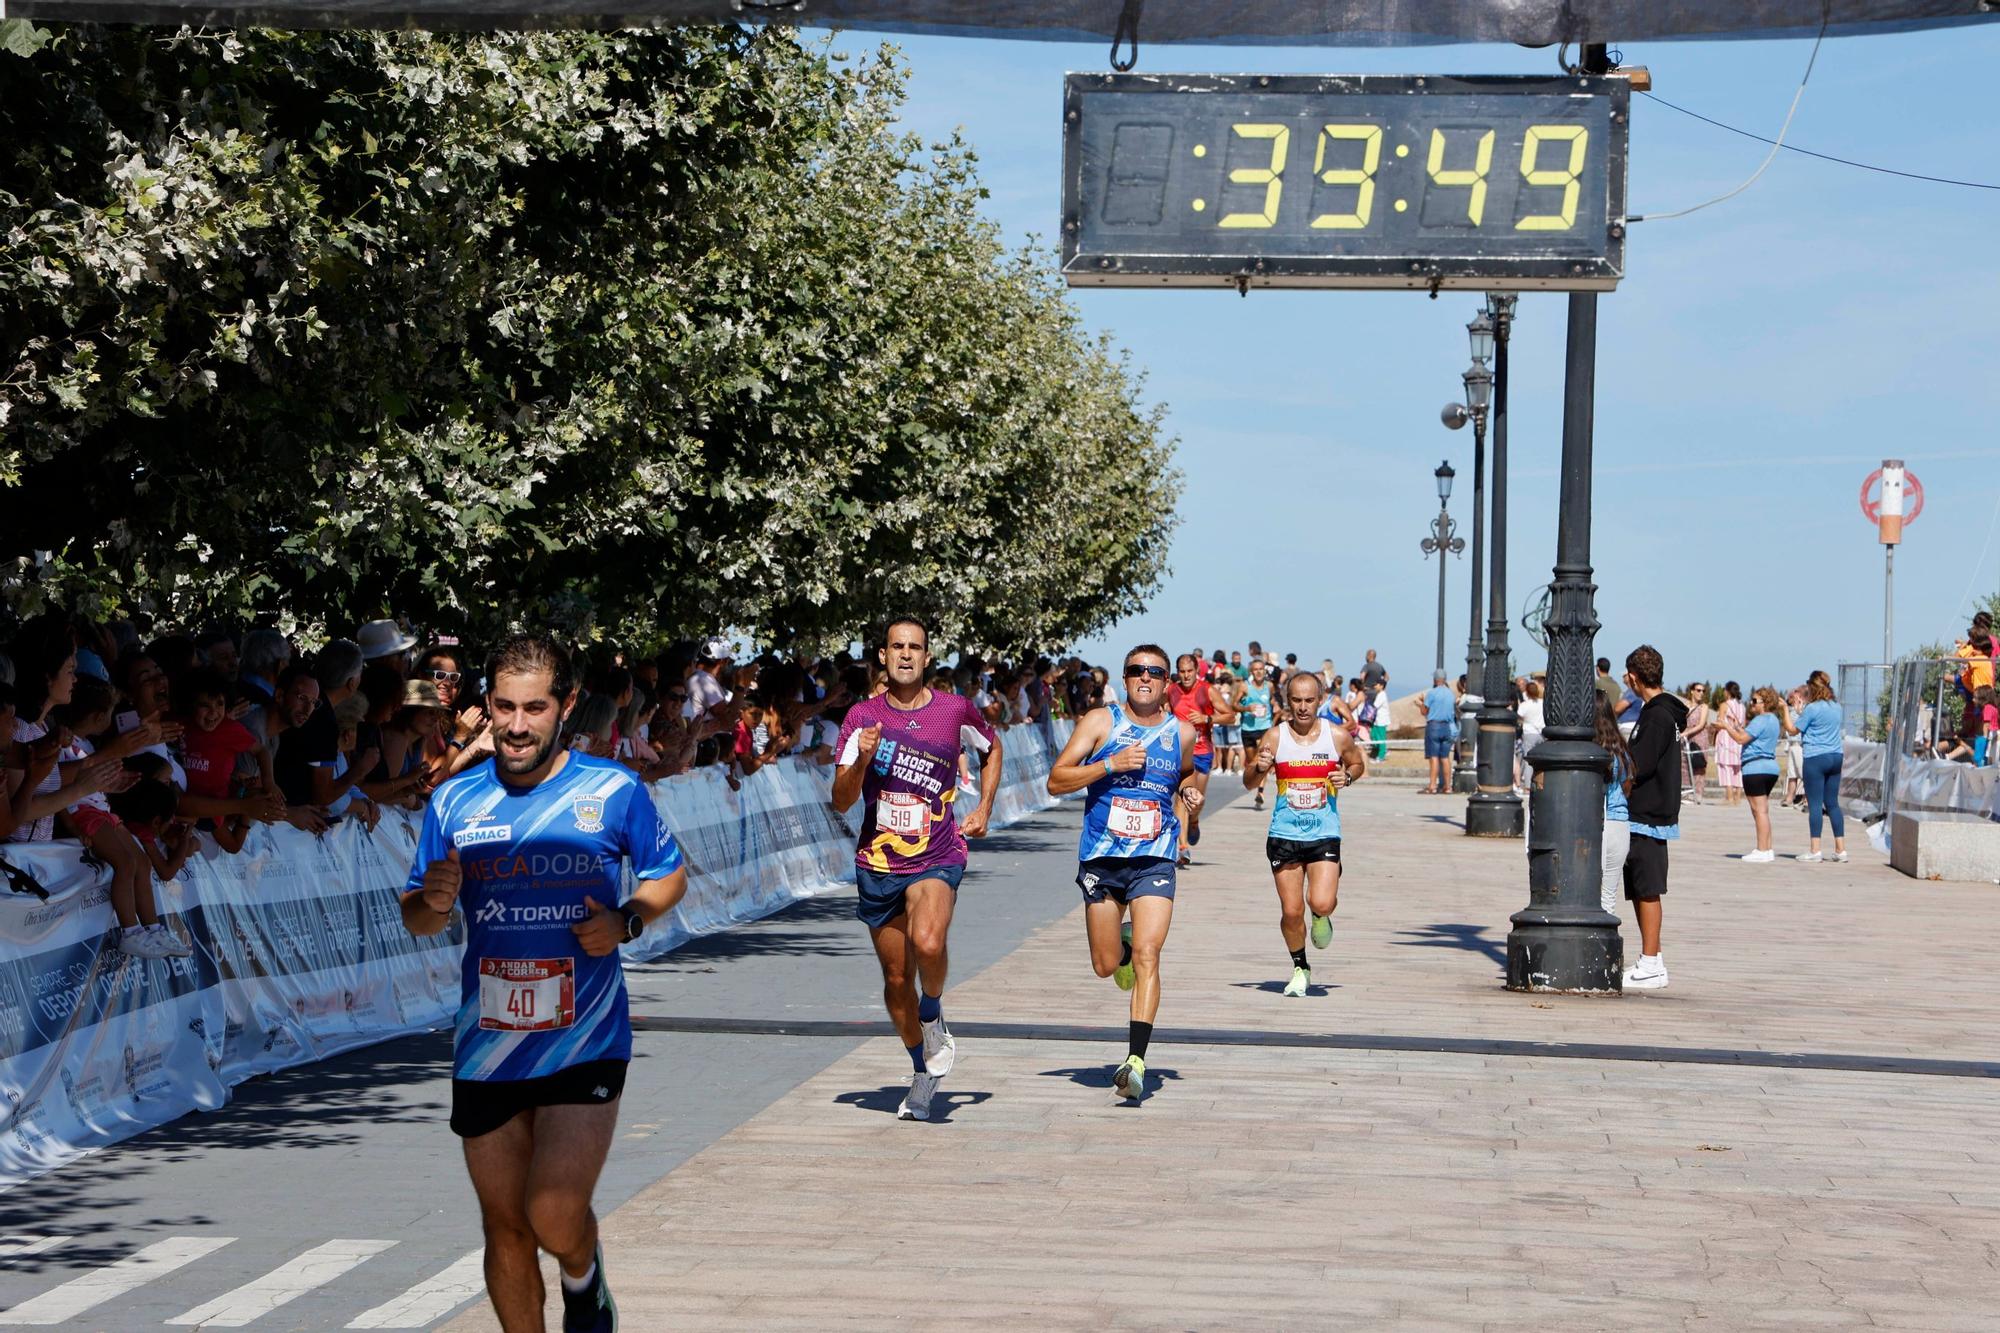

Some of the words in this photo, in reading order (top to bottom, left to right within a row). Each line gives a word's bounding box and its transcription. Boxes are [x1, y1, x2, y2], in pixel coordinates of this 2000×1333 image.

[895, 752, 935, 774] MOST
[1288, 760, 1328, 768] RIBADAVIA
[891, 765, 943, 795] WANTED
[1299, 793, 1312, 805] 68
[890, 809, 911, 828] 519
[1125, 814, 1142, 832] 33
[455, 828, 507, 846] DISMAC
[501, 961, 536, 969] ANDAR
[507, 968, 549, 977] CORRER
[30, 969, 72, 996] SEMPRE
[69, 963, 90, 981] CO
[507, 988, 535, 1018] 40
